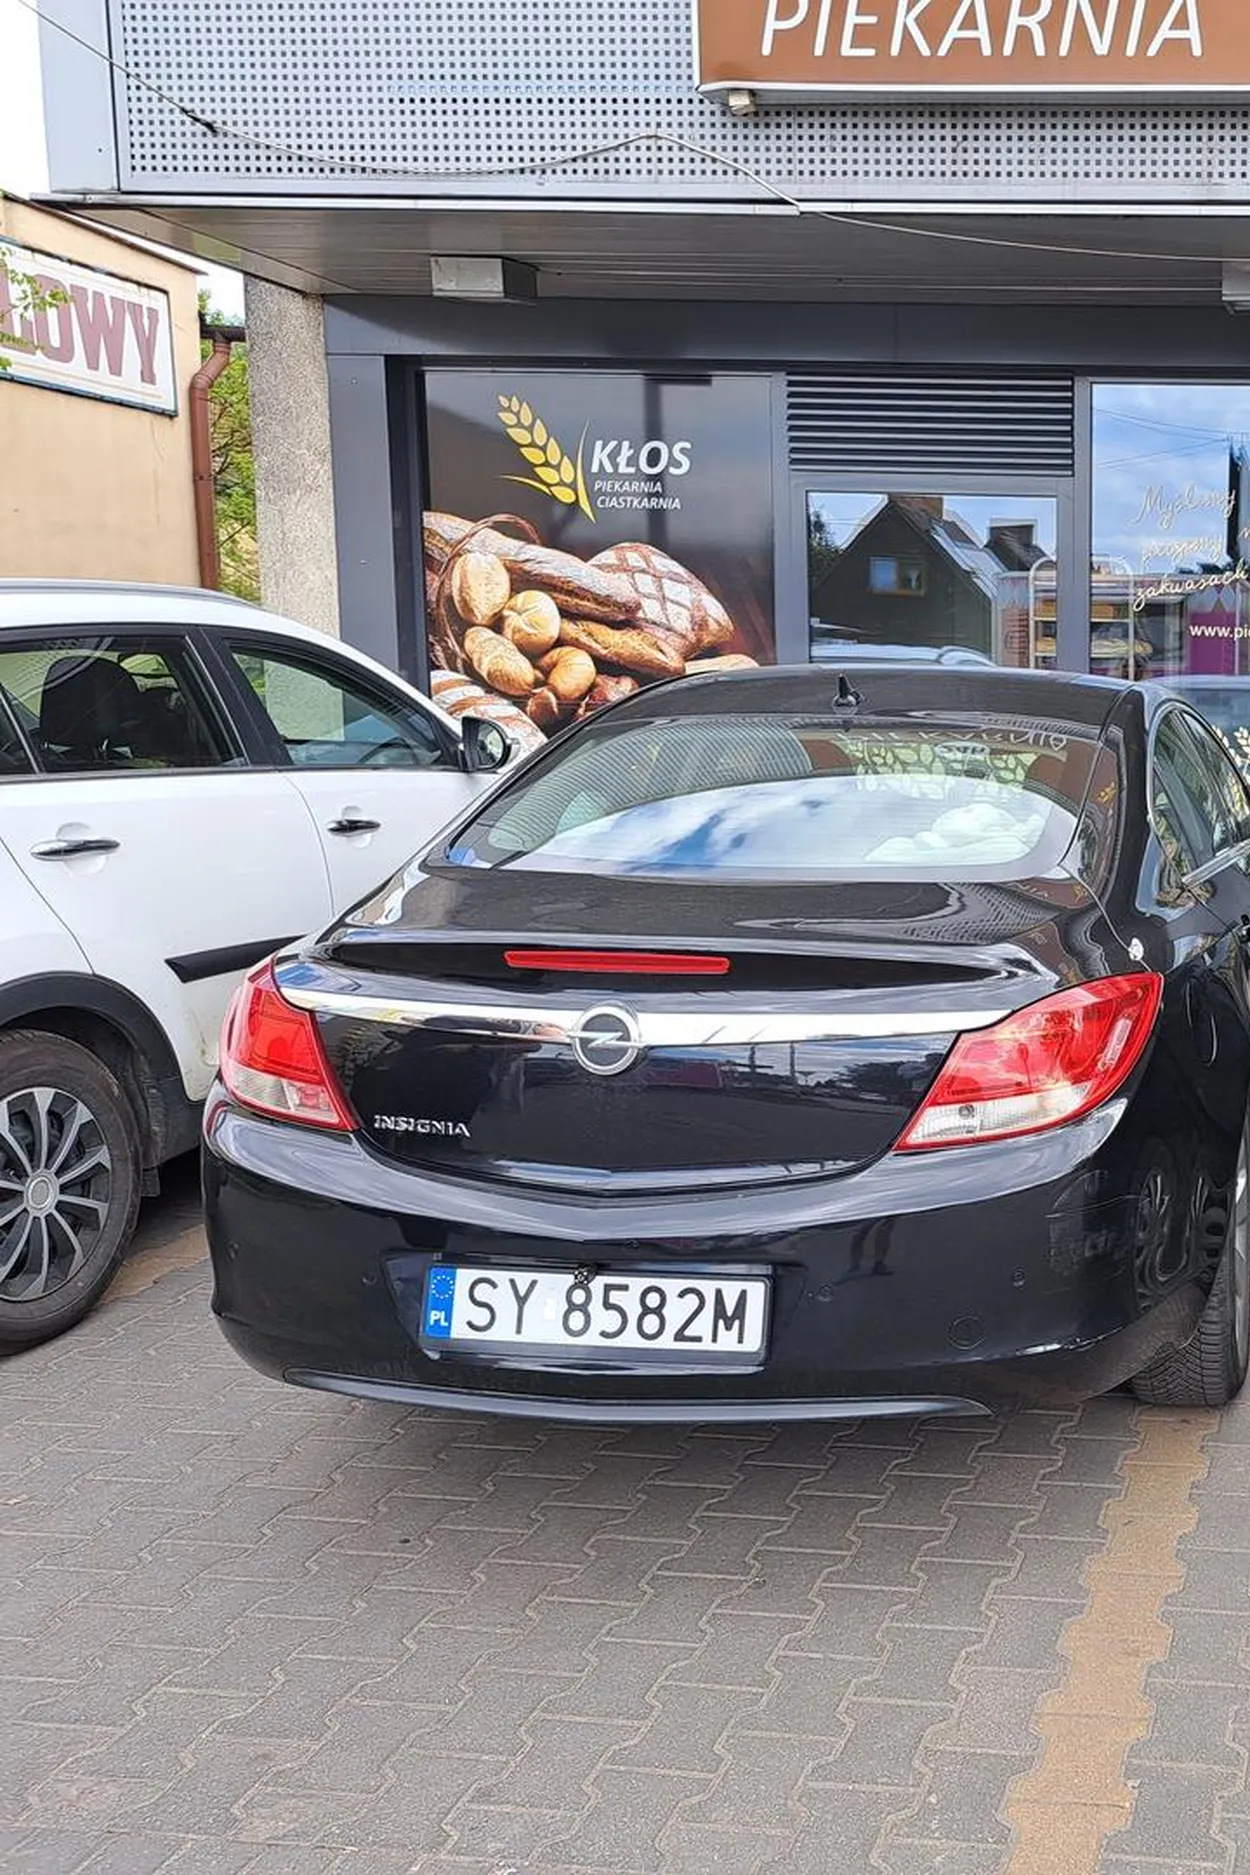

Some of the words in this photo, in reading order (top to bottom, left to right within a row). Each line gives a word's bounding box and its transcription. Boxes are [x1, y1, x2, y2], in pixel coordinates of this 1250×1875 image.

[761, 0, 1203, 57] PIEKARNIA
[591, 440, 692, 475] KŁOS
[594, 480, 662, 493] PIEKARNIA
[597, 495, 681, 510] CIASTKARNIA
[1132, 557, 1249, 612] zakwasach
[374, 1114, 471, 1138] INSIGNIA
[430, 1310, 449, 1327] PL
[466, 1276, 539, 1335] SY
[561, 1285, 749, 1345] 8582M
